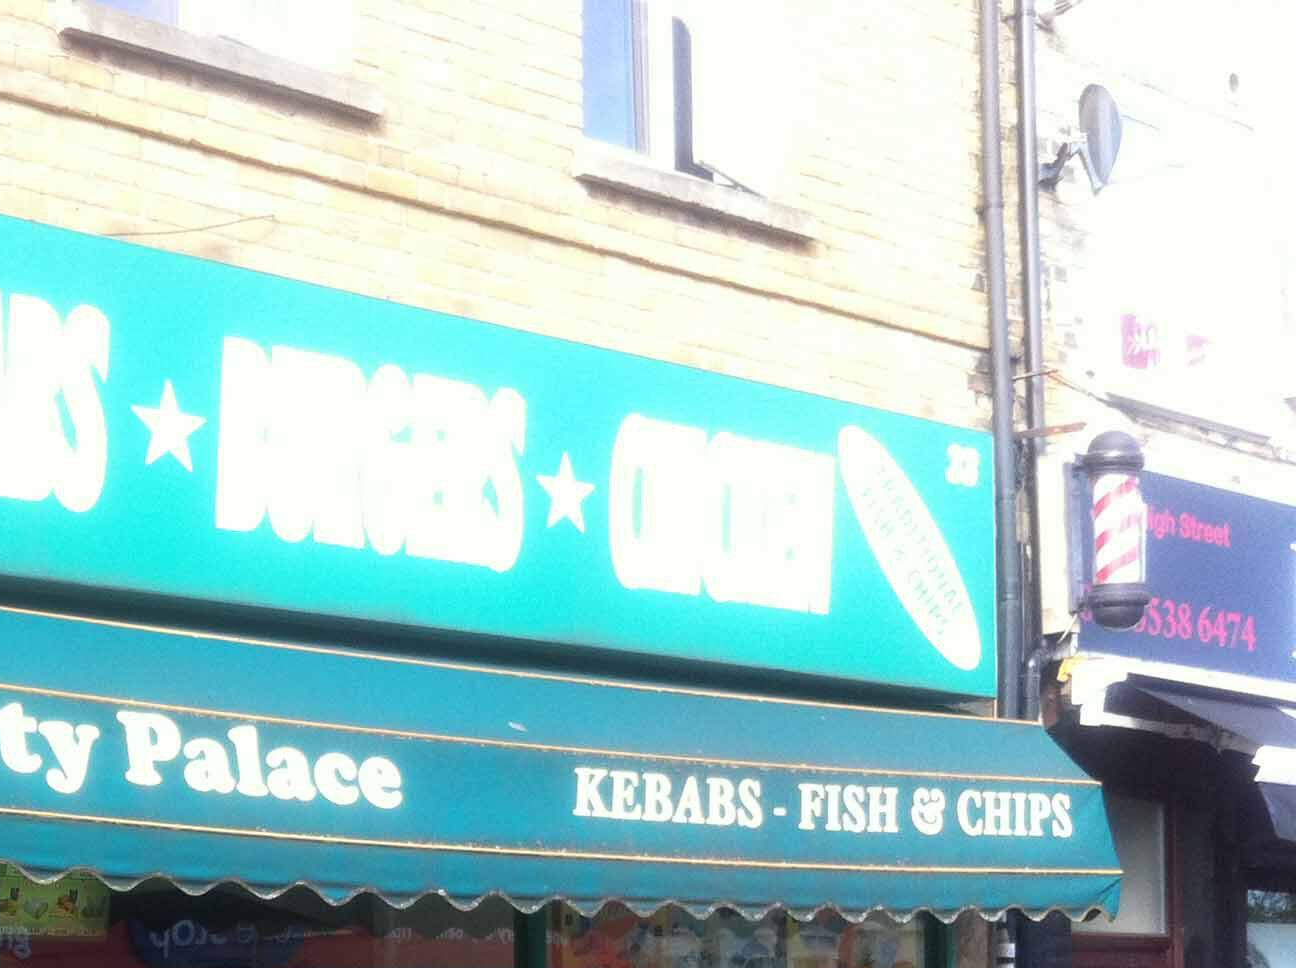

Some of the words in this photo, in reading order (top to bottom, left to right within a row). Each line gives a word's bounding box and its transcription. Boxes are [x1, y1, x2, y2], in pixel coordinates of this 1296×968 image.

[215, 336, 528, 573] BURGERS
[608, 412, 836, 615] CHICKEN
[1138, 505, 1177, 540] igh
[1179, 511, 1233, 548] Street
[1198, 606, 1258, 652] 6474
[116, 711, 404, 810] Palace
[572, 767, 764, 828] KEBABS
[798, 782, 900, 834] FISH
[910, 787, 947, 836] &
[956, 789, 1074, 838] CHIPS
